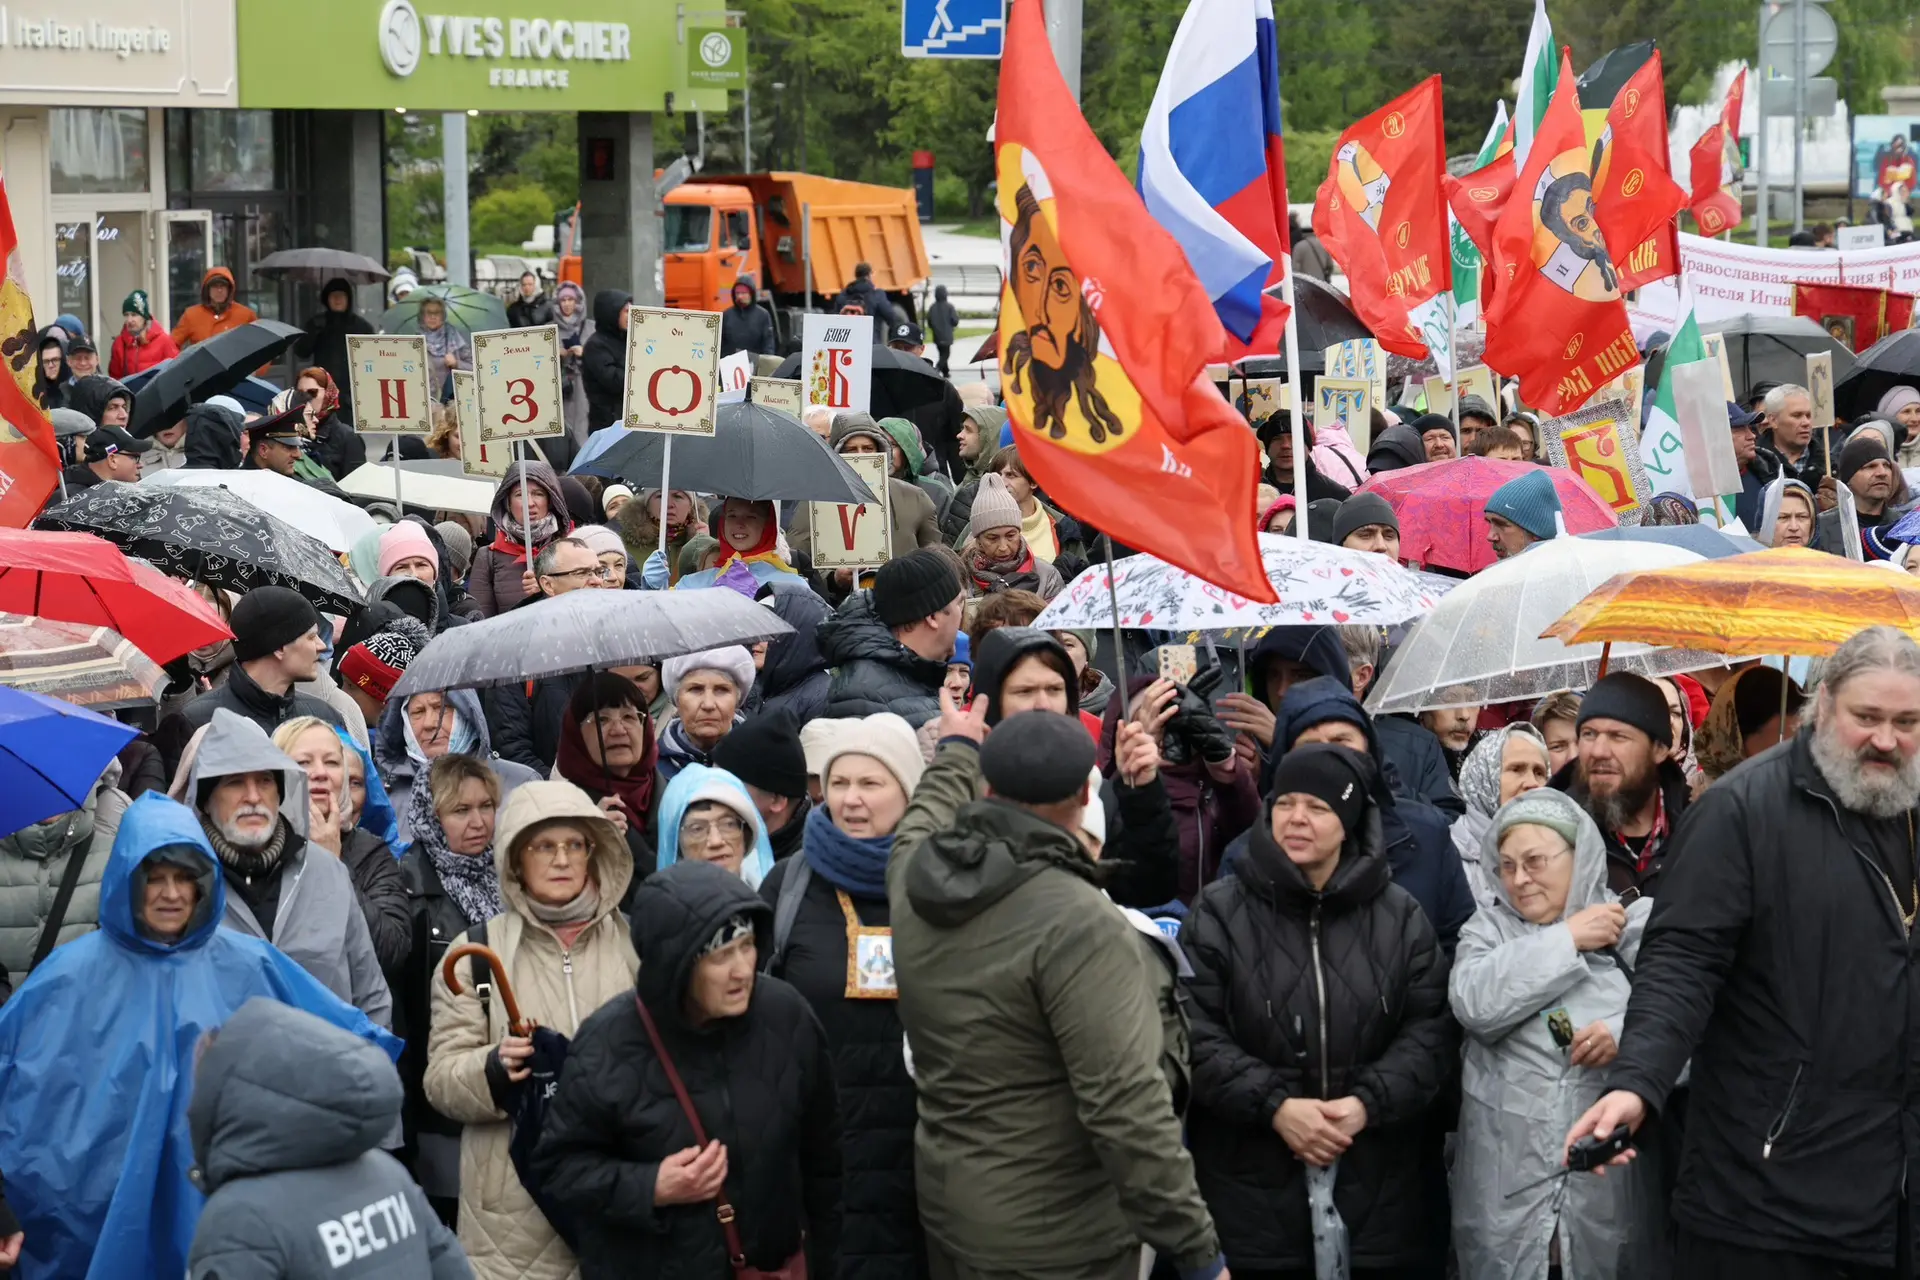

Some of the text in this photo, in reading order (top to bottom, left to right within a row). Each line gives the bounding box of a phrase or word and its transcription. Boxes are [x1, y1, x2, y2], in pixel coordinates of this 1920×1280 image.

[14, 17, 84, 49] Italian
[88, 19, 171, 58] lingerie
[424, 15, 631, 60] YVES ROCHER
[489, 68, 570, 88] FRANCE
[402, 365, 415, 374] 50
[503, 346, 530, 355] Земля
[535, 361, 541, 371] 7
[827, 349, 853, 408] Б
[377, 379, 410, 419] Н
[318, 1192, 416, 1268] ВЕСТИ
